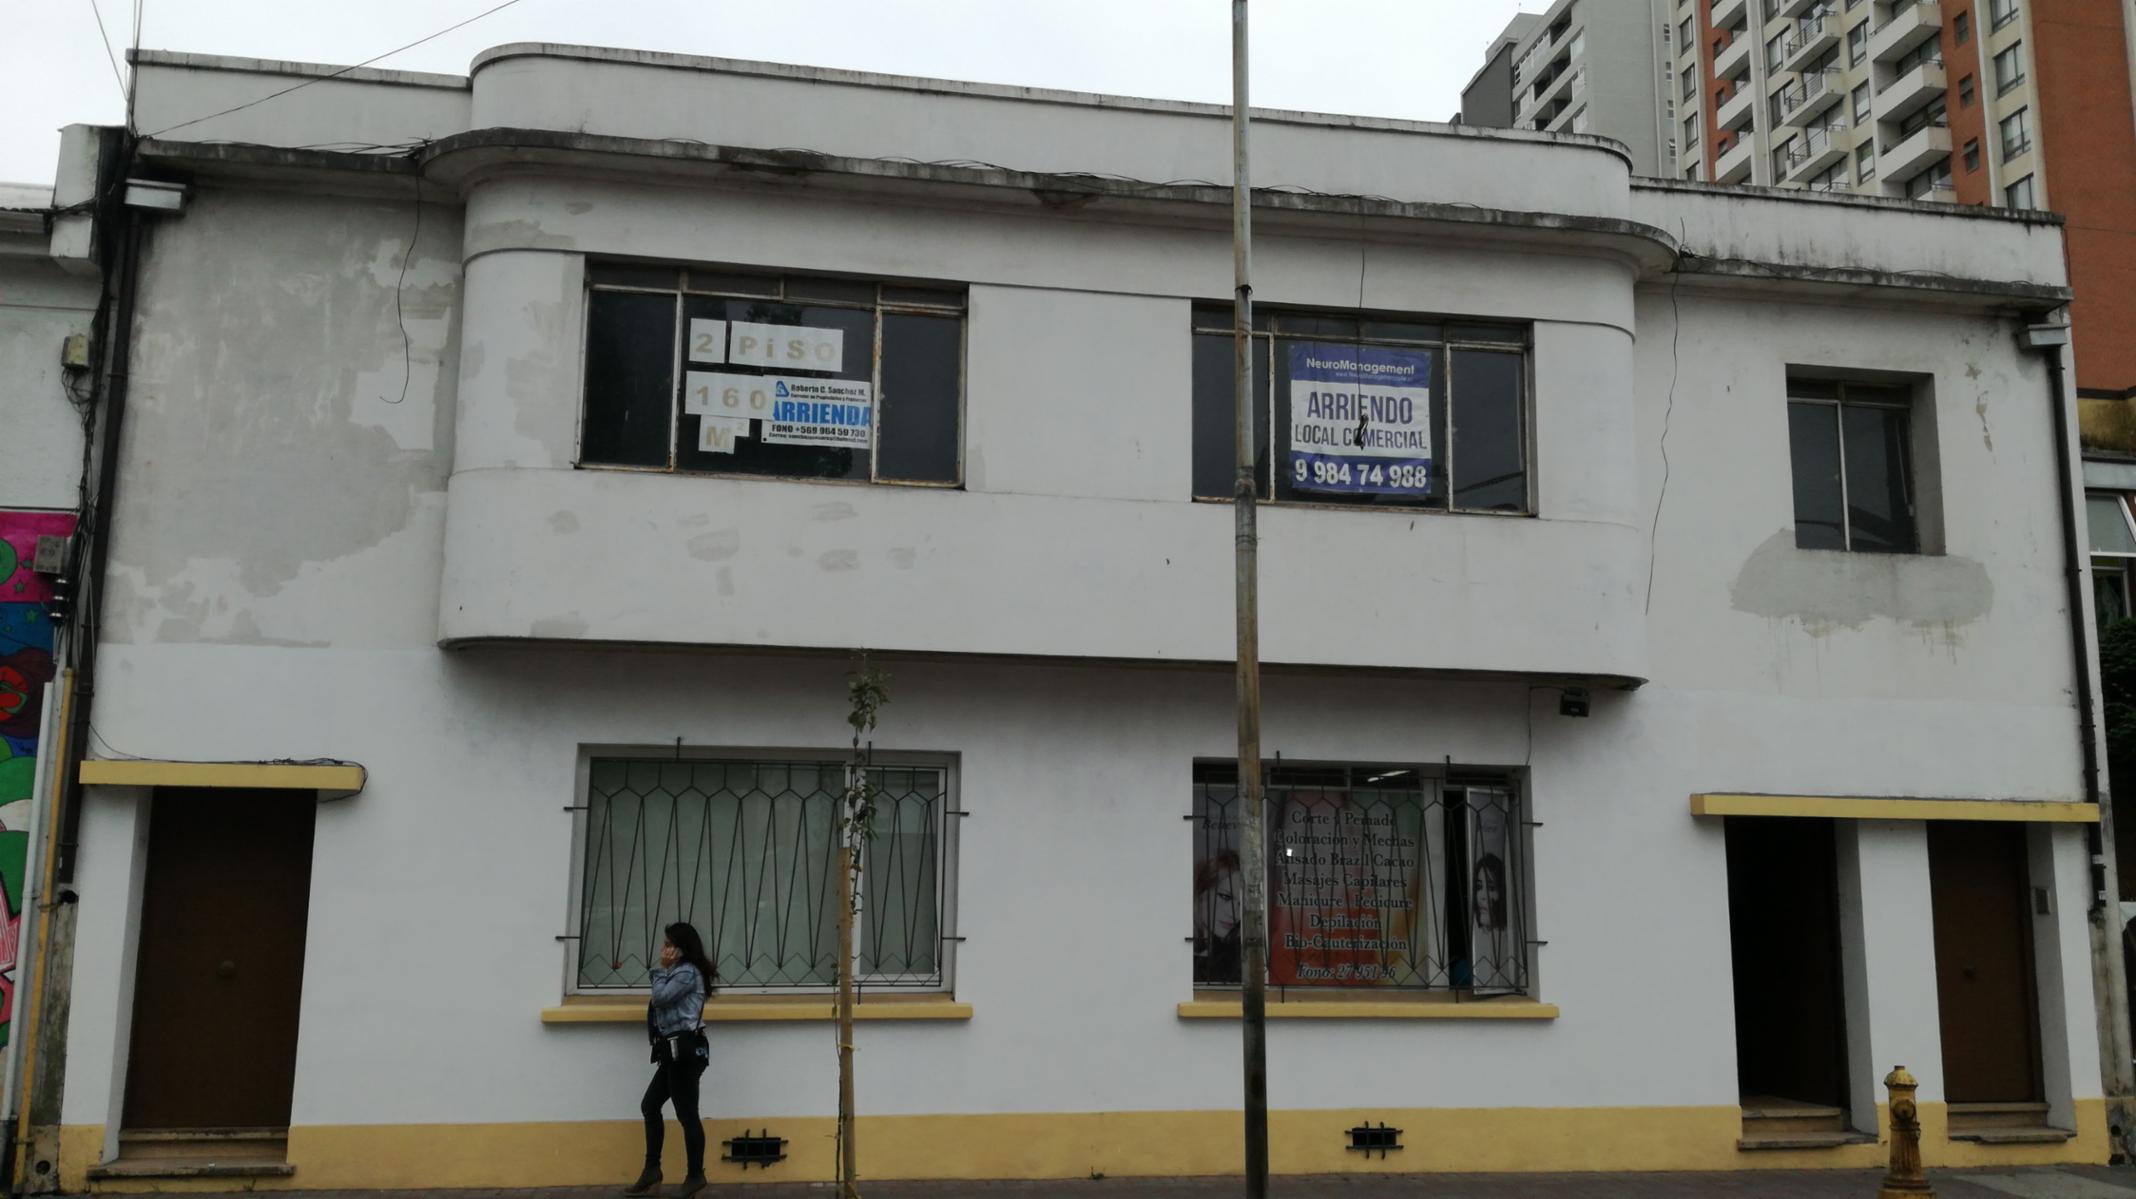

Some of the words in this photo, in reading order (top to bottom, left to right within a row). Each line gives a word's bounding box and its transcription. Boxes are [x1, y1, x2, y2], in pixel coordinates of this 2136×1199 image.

[695, 333, 713, 353] 2
[1306, 358, 1415, 375] NeuroManagement
[695, 385, 767, 411] 160
[773, 400, 872, 427] ARRIENDA
[1306, 391, 1413, 425] ARRIENDO
[772, 424, 794, 433] FONO
[1295, 424, 1339, 446] LOCAL
[1343, 427, 1427, 449] COMERCIAL
[1295, 458, 1308, 482] 9
[1314, 461, 1351, 485] 984
[1357, 464, 1384, 486] 74
[1389, 465, 1427, 488] 988
[1291, 811, 1330, 825] Corte
[1350, 836, 1360, 848] y
[1373, 853, 1415, 867] Cacao
[1284, 871, 1339, 889] Masajes
[1344, 873, 1408, 890] Capilares
[1279, 893, 1343, 907] Manicure
[1355, 894, 1413, 909] Pedicure
